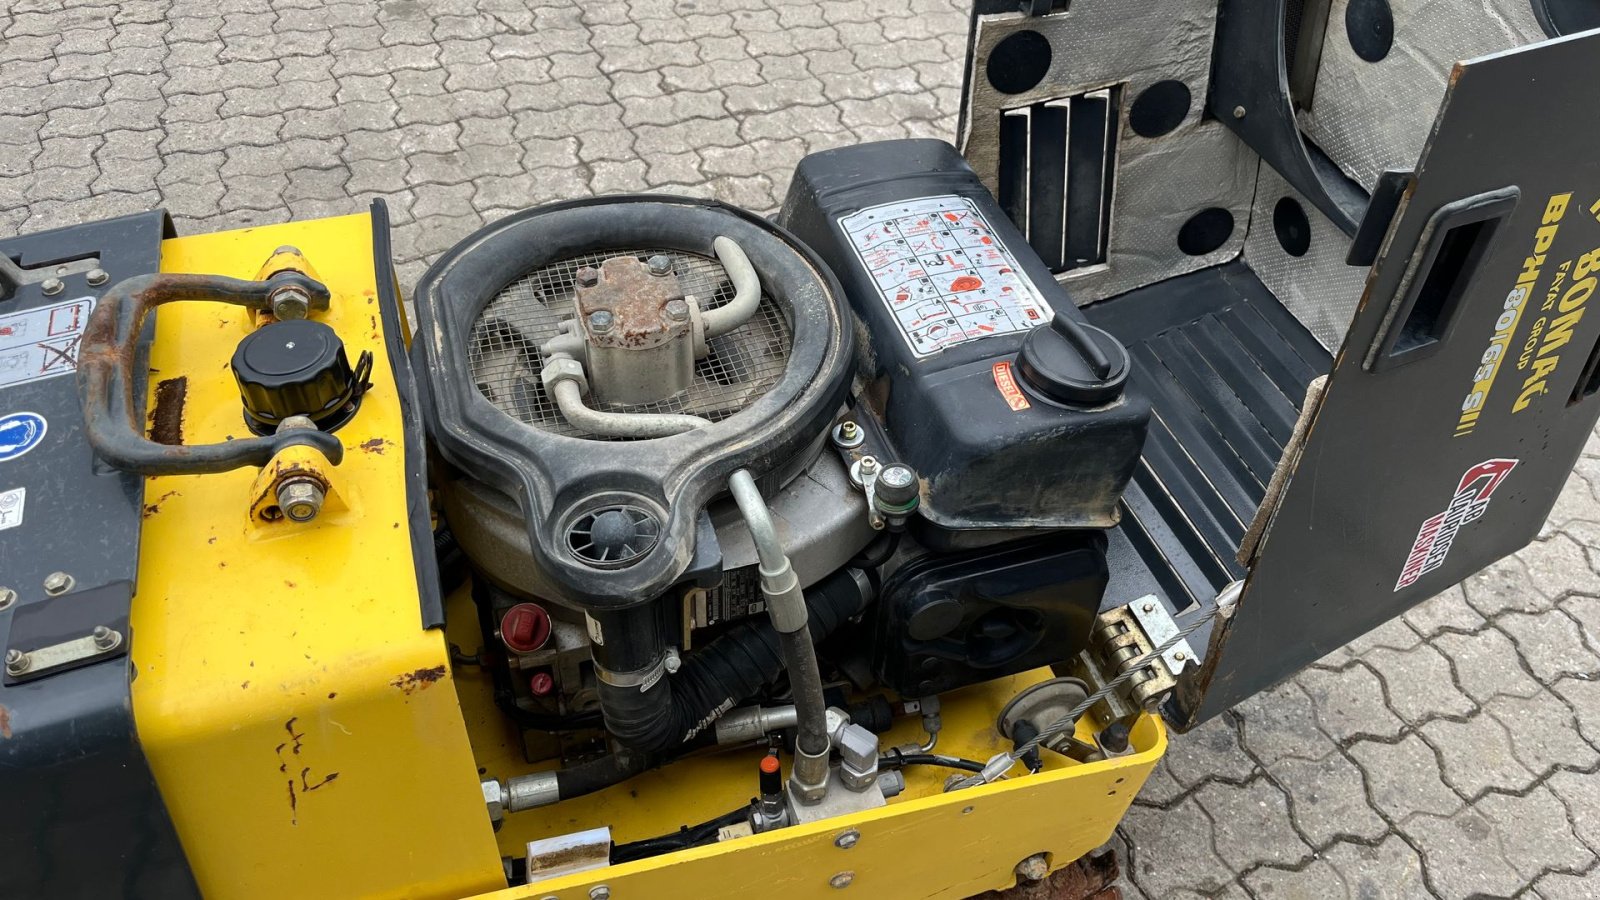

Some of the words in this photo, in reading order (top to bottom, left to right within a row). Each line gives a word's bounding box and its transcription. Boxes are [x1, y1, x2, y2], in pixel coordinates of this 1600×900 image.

[1541, 260, 1572, 311] FAYAT
[1517, 316, 1547, 370] GROUP
[996, 364, 1017, 396] DIESEL
[1463, 500, 1488, 523] AB
[1400, 512, 1446, 586] MASKINER
